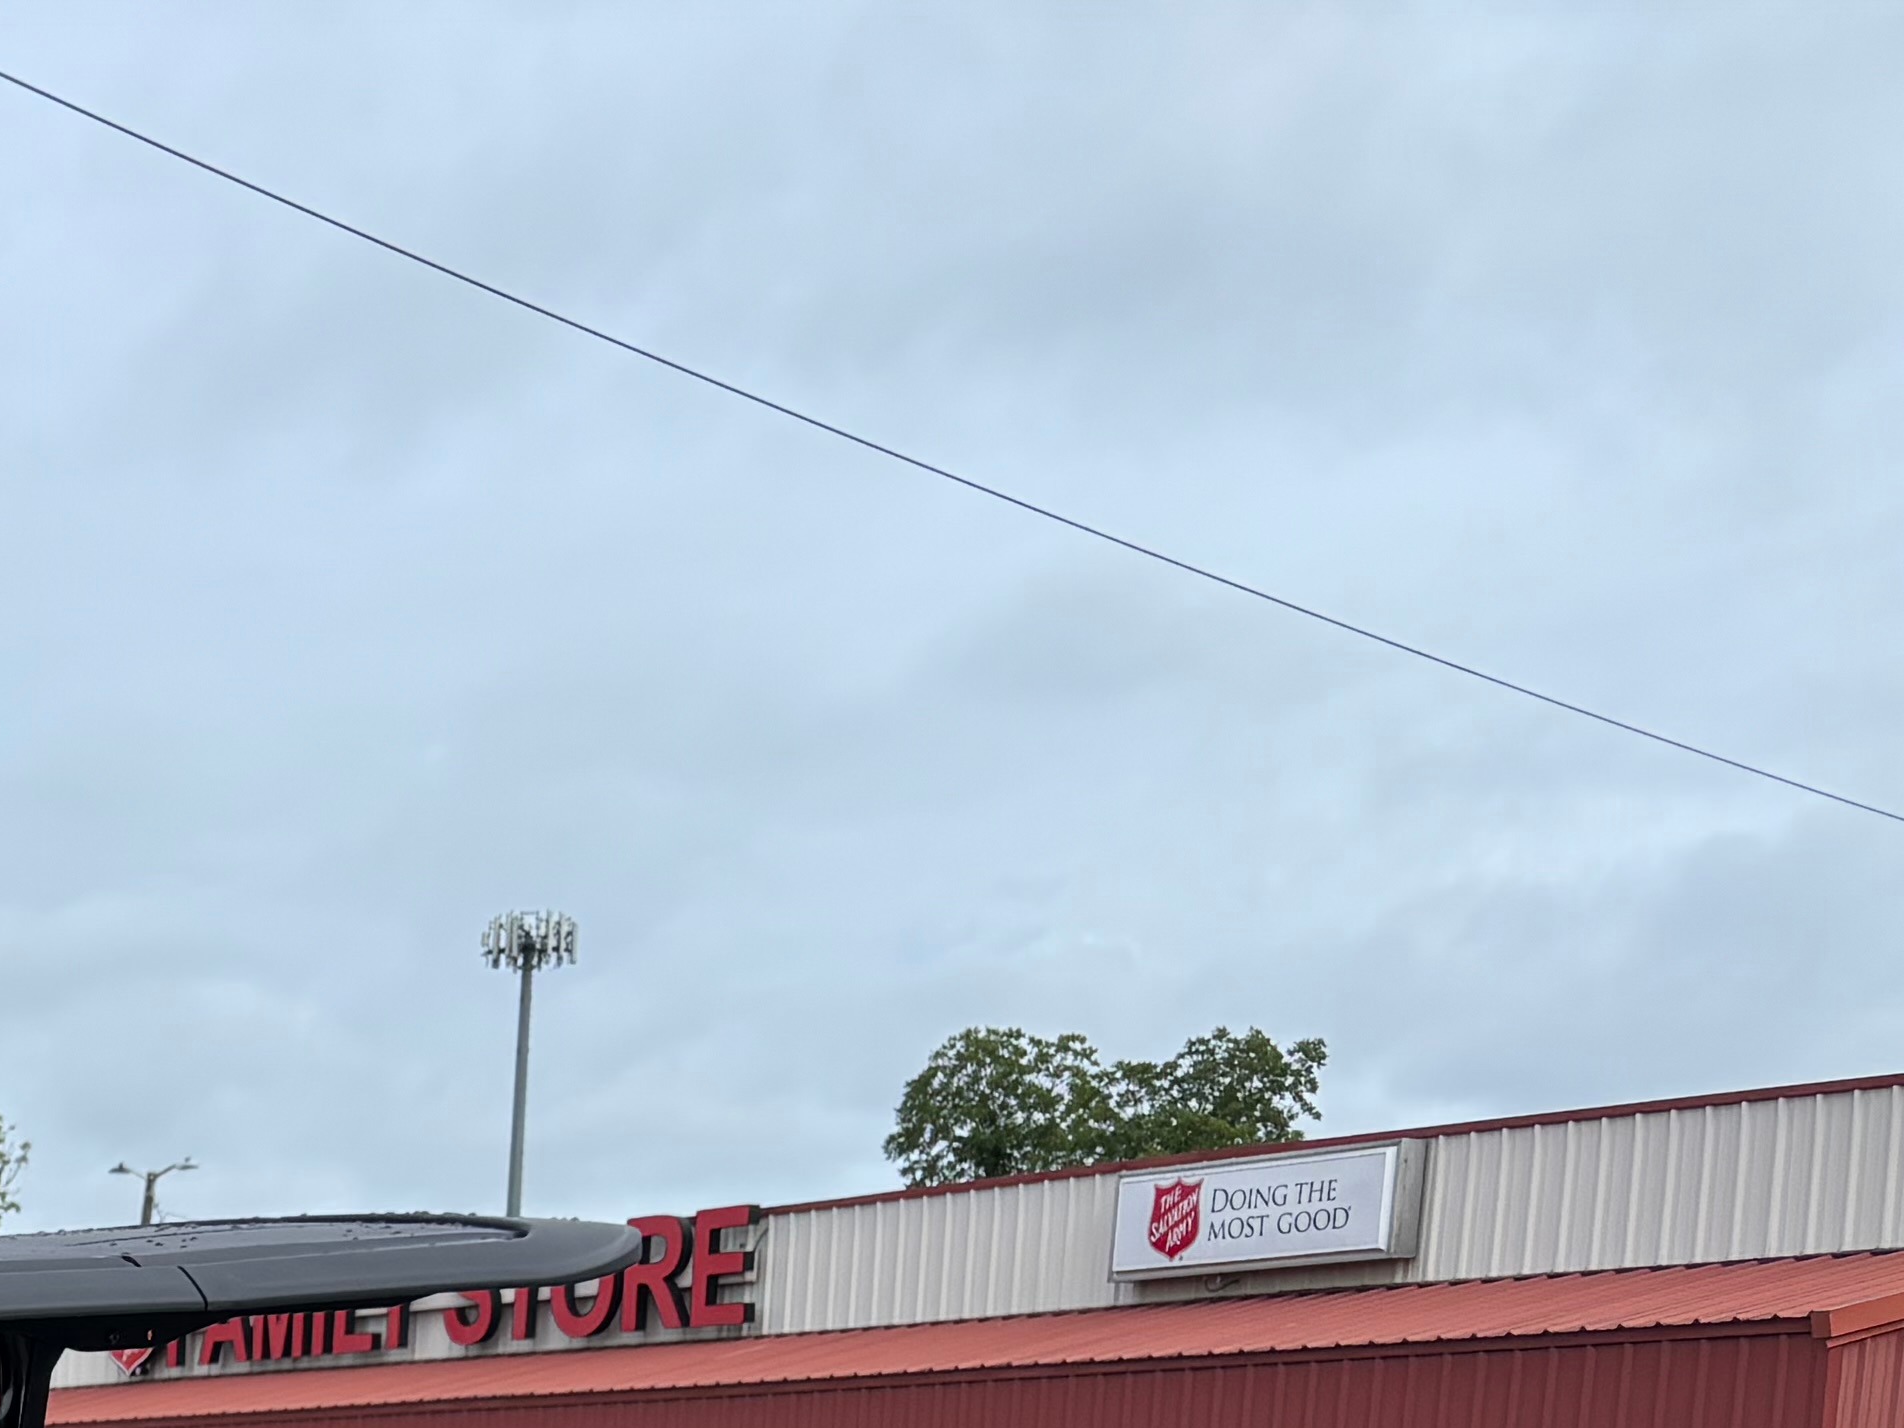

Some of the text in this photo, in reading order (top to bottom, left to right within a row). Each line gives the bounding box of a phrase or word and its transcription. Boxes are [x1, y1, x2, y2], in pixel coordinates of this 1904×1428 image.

[1160, 1185, 1183, 1211] THE
[1210, 1179, 1338, 1213] DOING THE
[1150, 1188, 1200, 1242] SALVATION
[1207, 1207, 1350, 1242] MOST GOOD
[1165, 1214, 1196, 1253] ARMY
